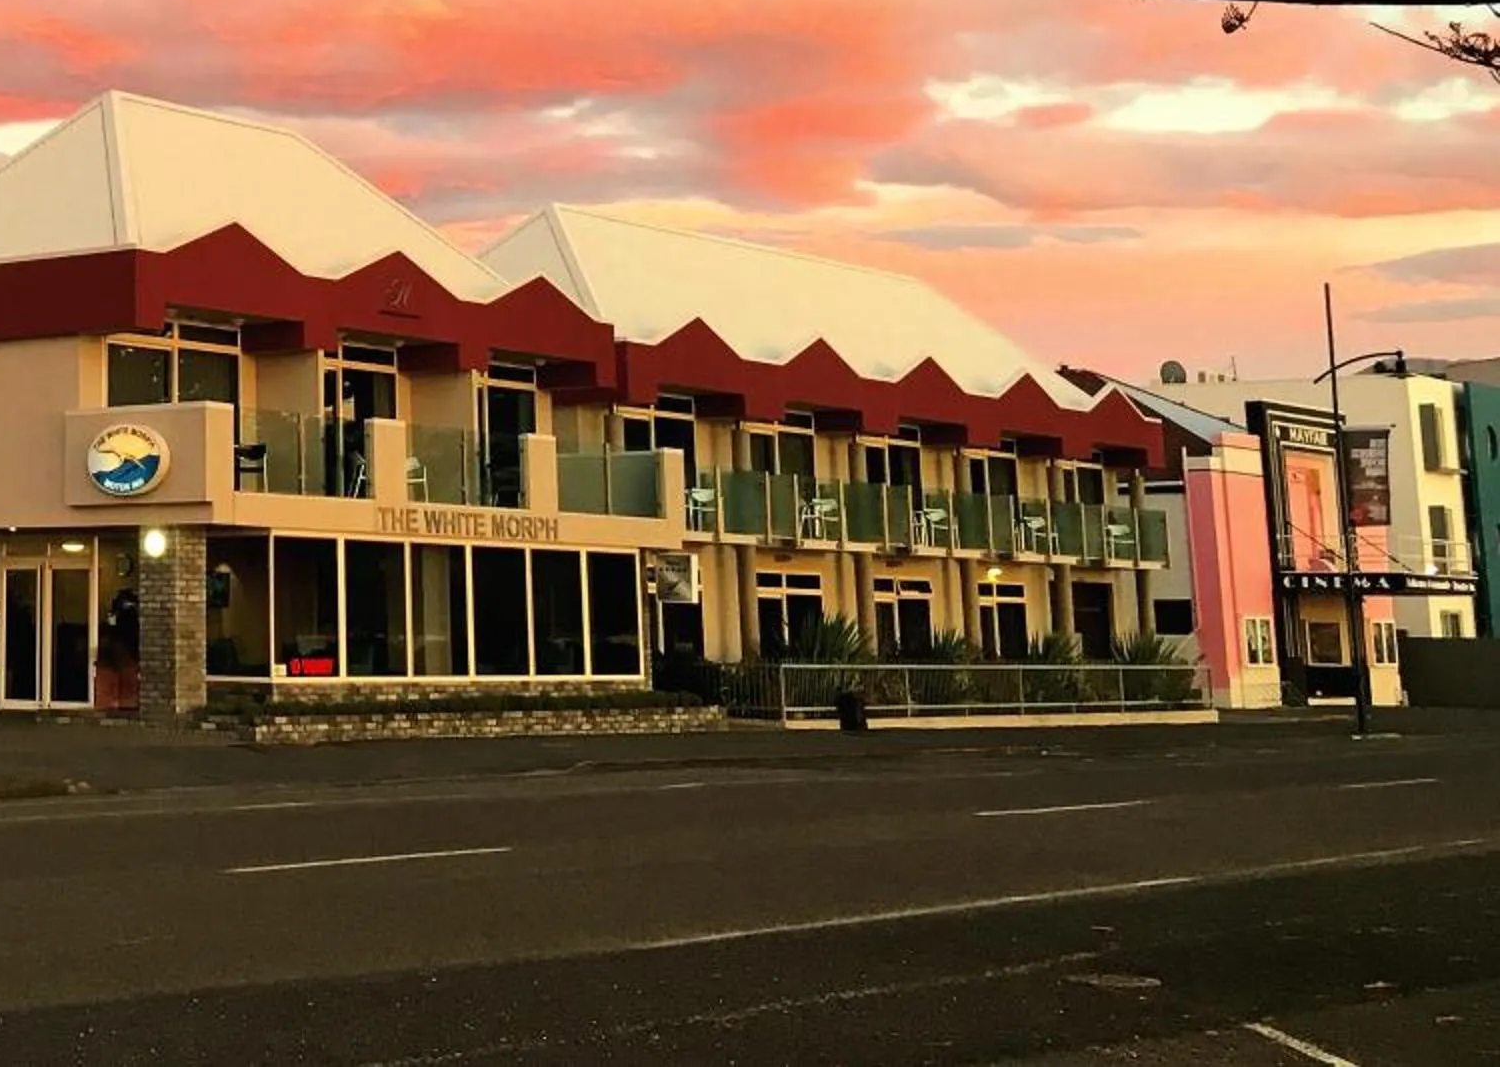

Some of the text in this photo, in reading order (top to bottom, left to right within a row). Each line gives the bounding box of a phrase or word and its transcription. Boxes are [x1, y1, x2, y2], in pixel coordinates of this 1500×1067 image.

[1289, 427, 1328, 446] MAYFAIR
[378, 507, 558, 541] THE WHITE MORPH
[1283, 575, 1391, 589] CINEMA
